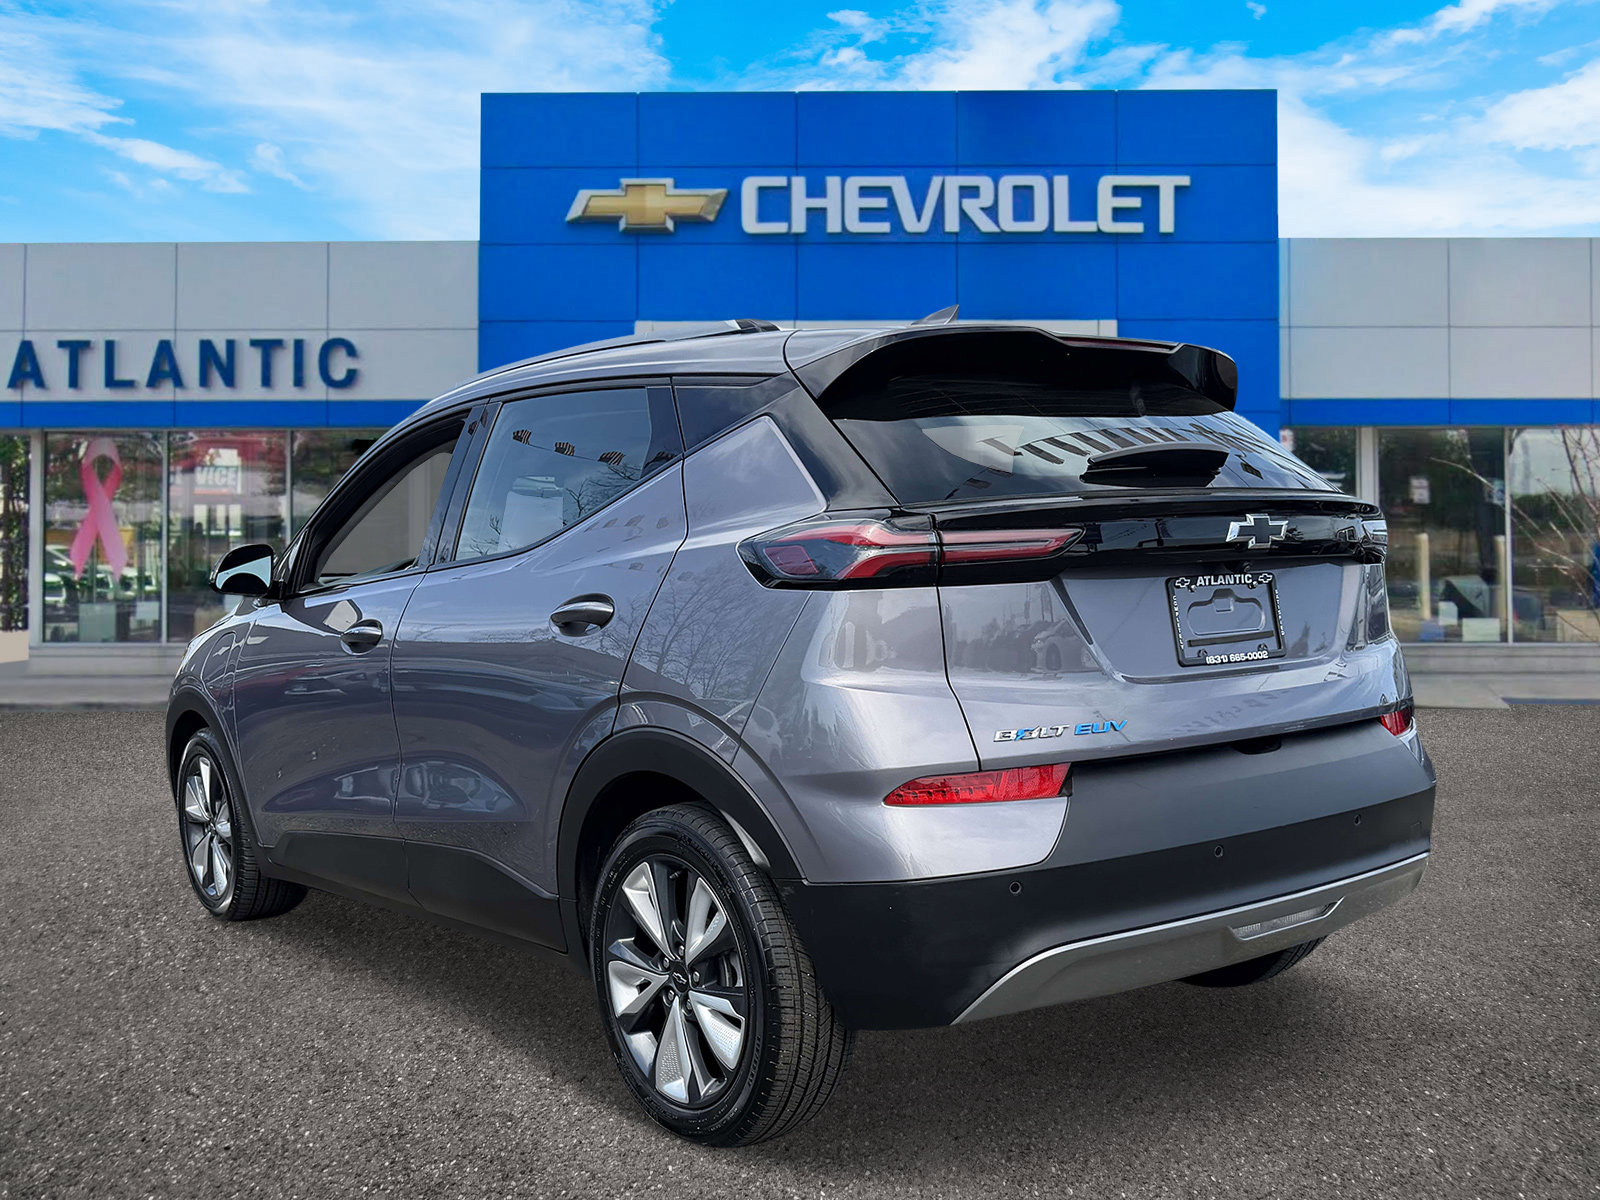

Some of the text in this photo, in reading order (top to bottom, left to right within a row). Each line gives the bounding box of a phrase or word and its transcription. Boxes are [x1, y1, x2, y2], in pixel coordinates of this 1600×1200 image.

[741, 175, 1191, 234] CHEVROLET
[7, 337, 360, 390] ATLANTIC
[1196, 574, 1253, 586] ATLANTIC
[993, 719, 1128, 742] BOLT EUV
